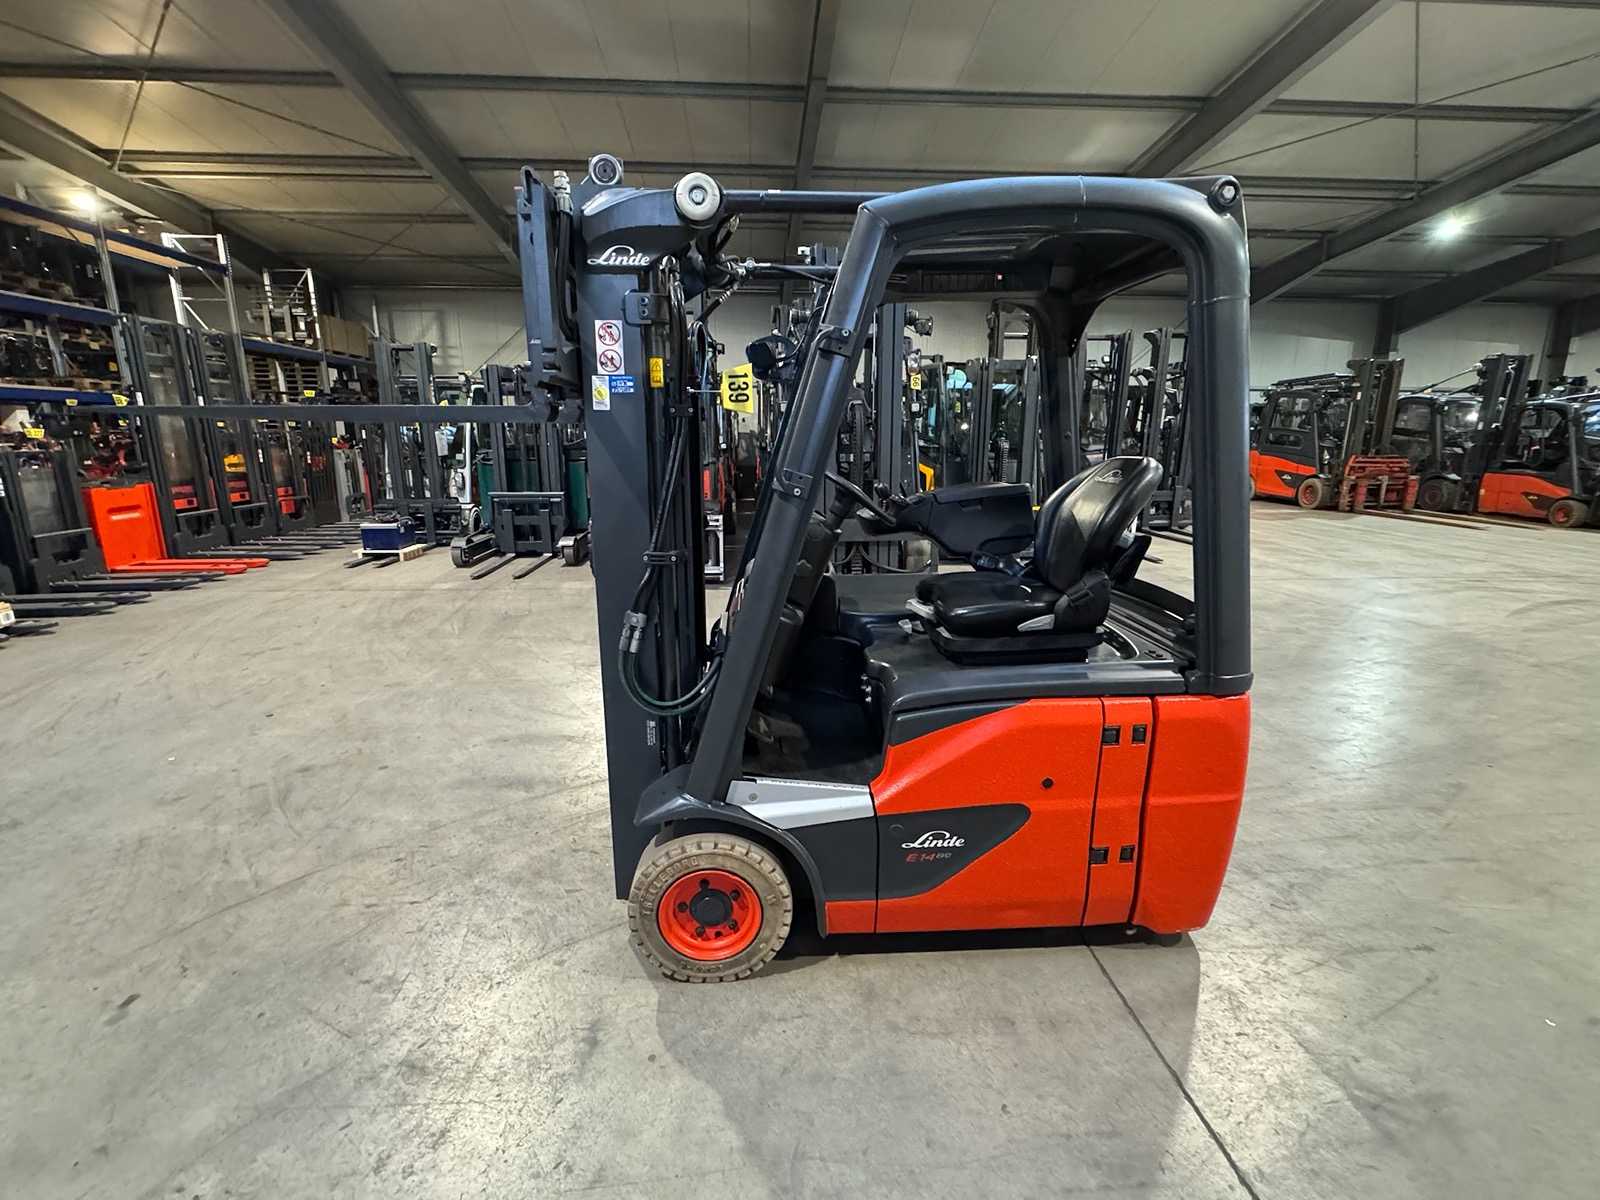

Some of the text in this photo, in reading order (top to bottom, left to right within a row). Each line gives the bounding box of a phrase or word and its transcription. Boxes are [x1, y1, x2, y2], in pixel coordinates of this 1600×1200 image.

[586, 244, 650, 266] Linde
[728, 372, 750, 404] 139
[901, 830, 965, 849] Linde
